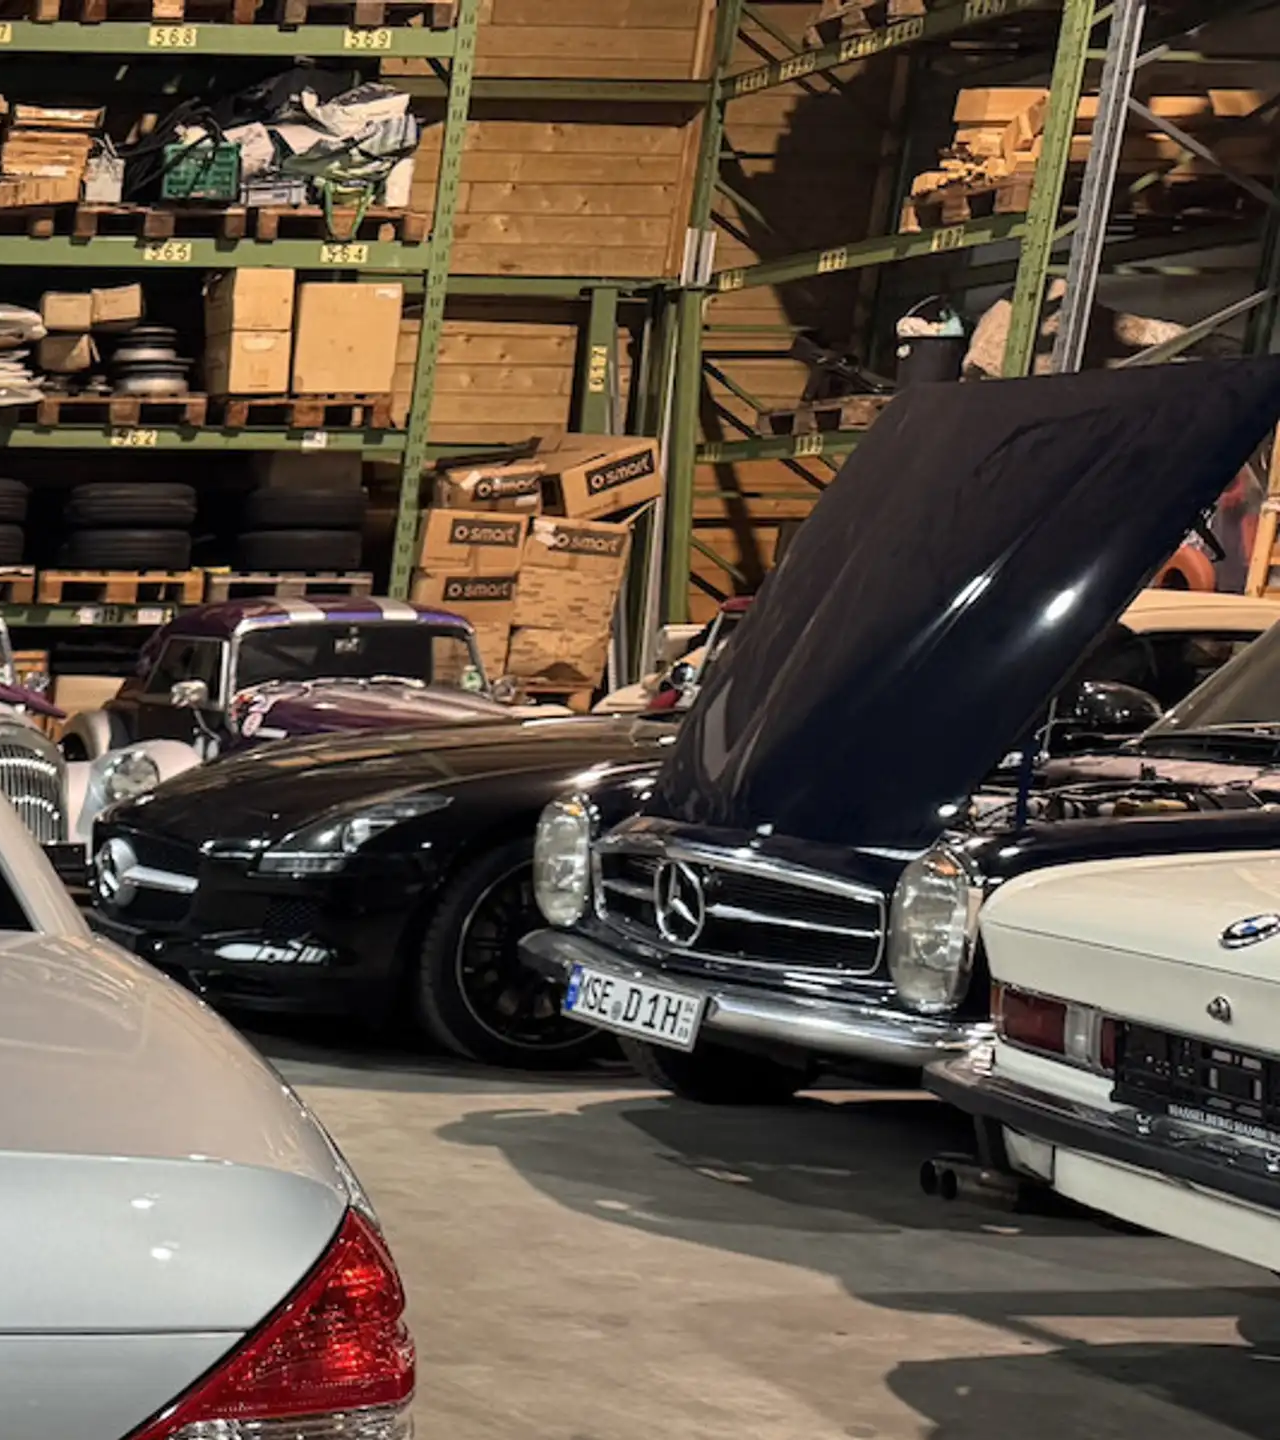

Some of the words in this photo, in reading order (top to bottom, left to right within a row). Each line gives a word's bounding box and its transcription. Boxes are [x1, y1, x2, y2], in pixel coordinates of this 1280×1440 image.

[156, 28, 193, 45] 568
[350, 29, 388, 47] 569
[471, 526, 517, 543] smart
[572, 537, 620, 553] smart
[464, 582, 510, 598] smart
[580, 973, 615, 1015] MSE
